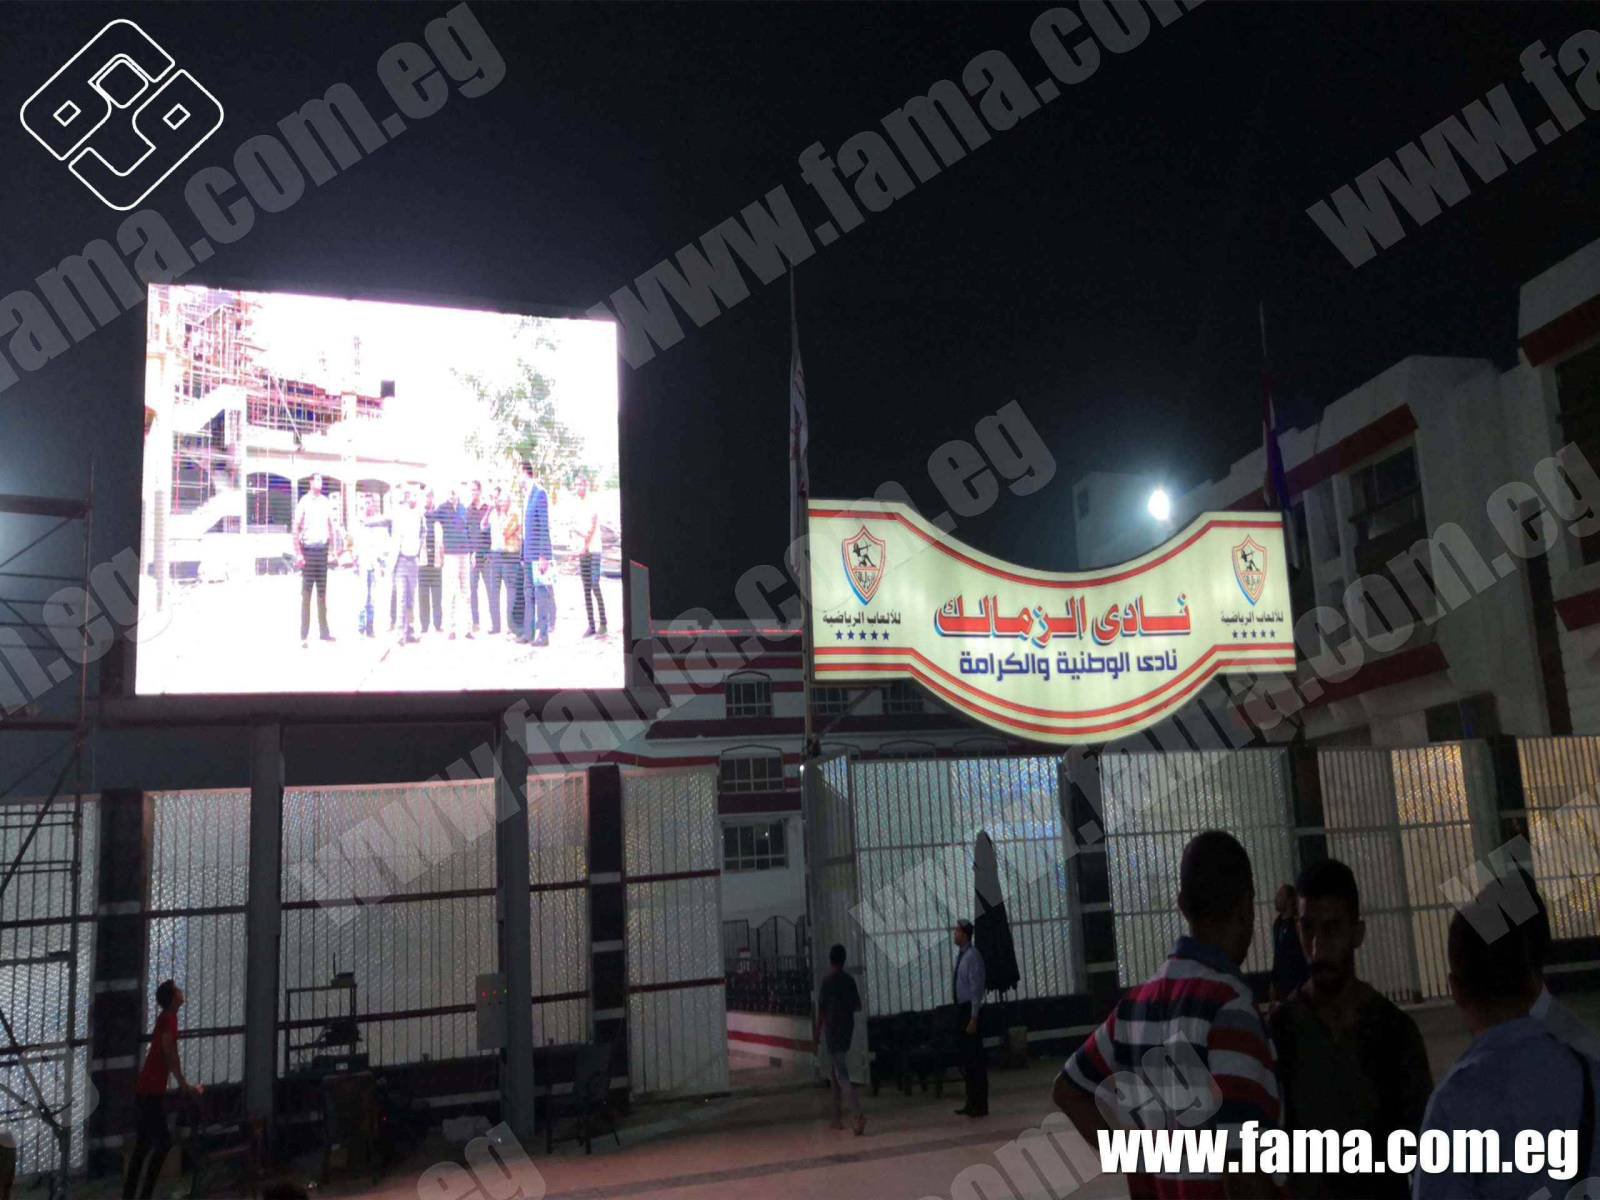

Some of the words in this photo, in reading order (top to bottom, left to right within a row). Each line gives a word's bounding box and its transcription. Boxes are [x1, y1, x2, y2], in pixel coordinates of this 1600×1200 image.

[822, 610, 864, 628] الرياضية
[934, 594, 1088, 649] الزمالك
[959, 650, 1050, 682] والكرامة
[1056, 650, 1131, 680] الوطنية
